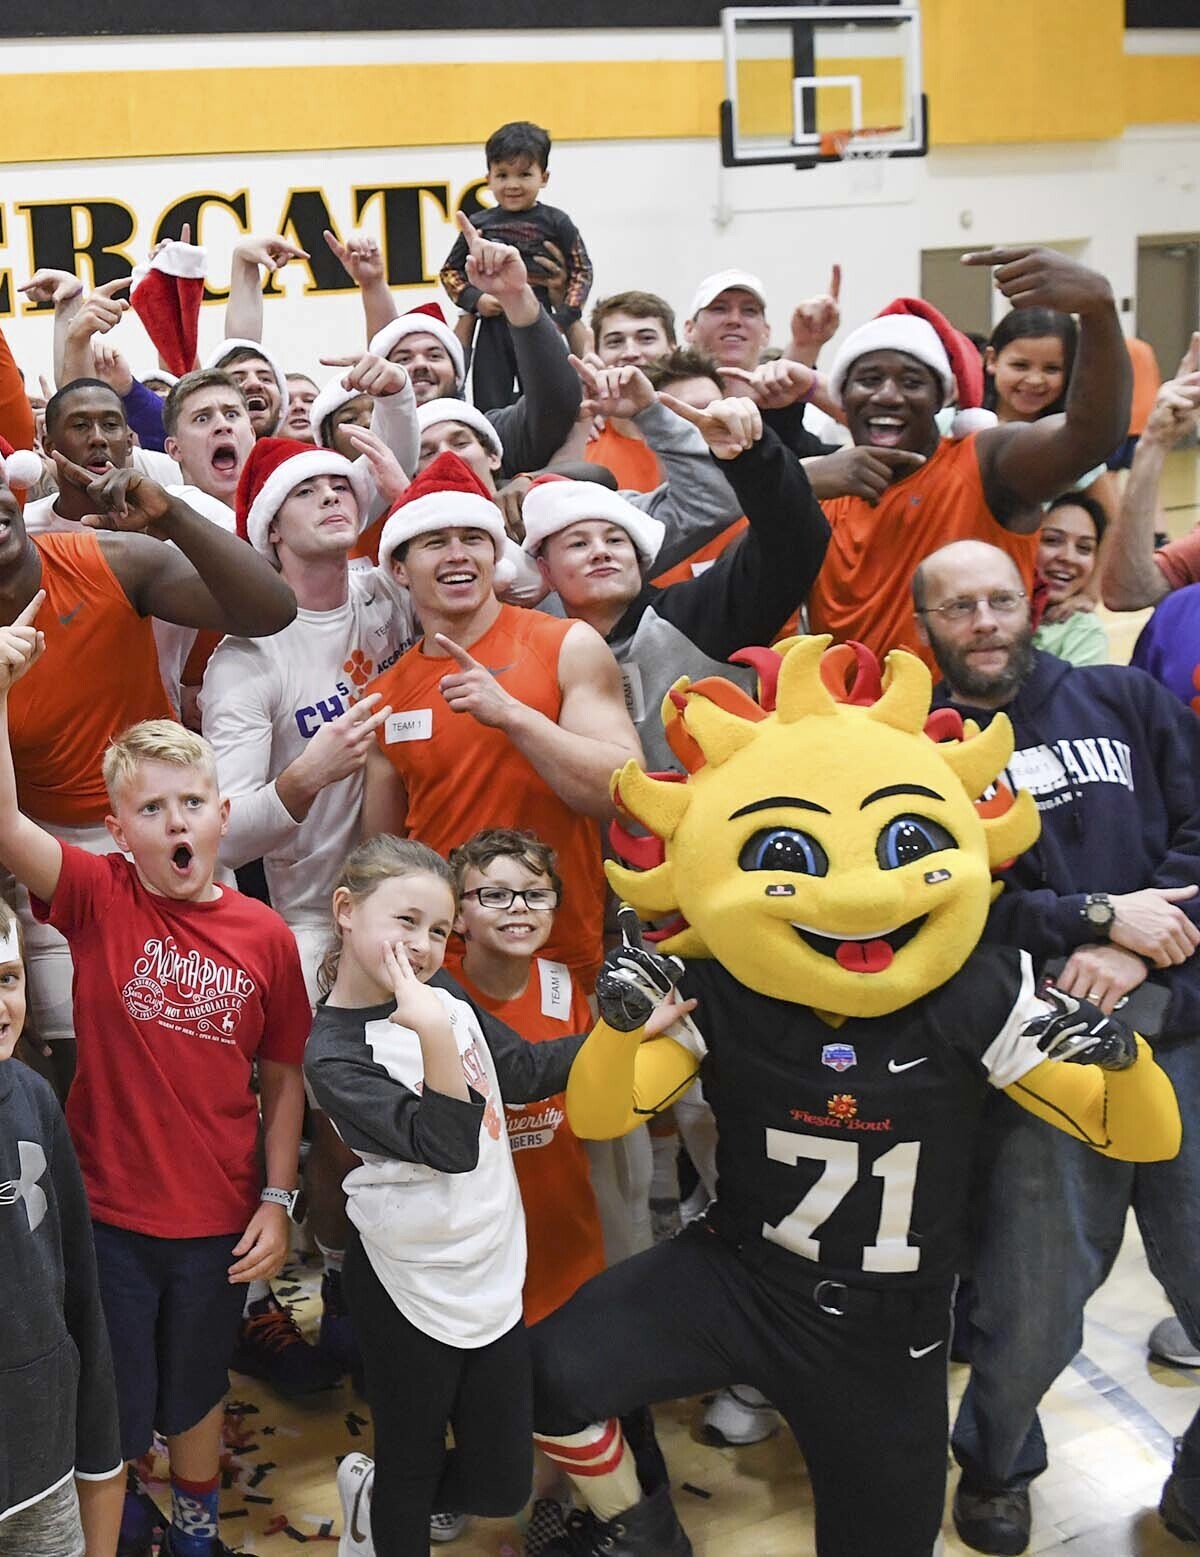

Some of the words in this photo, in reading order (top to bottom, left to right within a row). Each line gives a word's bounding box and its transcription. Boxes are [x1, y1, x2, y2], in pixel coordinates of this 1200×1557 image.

[392, 720, 415, 732] TEAM
[550, 977, 560, 1006] TEAM
[164, 1003, 181, 1018] HOT
[184, 999, 230, 1018] CHOCOLATE
[789, 1108, 841, 1128] Fiesta
[843, 1117, 892, 1131] Bowl
[761, 1128, 921, 1273] 71
